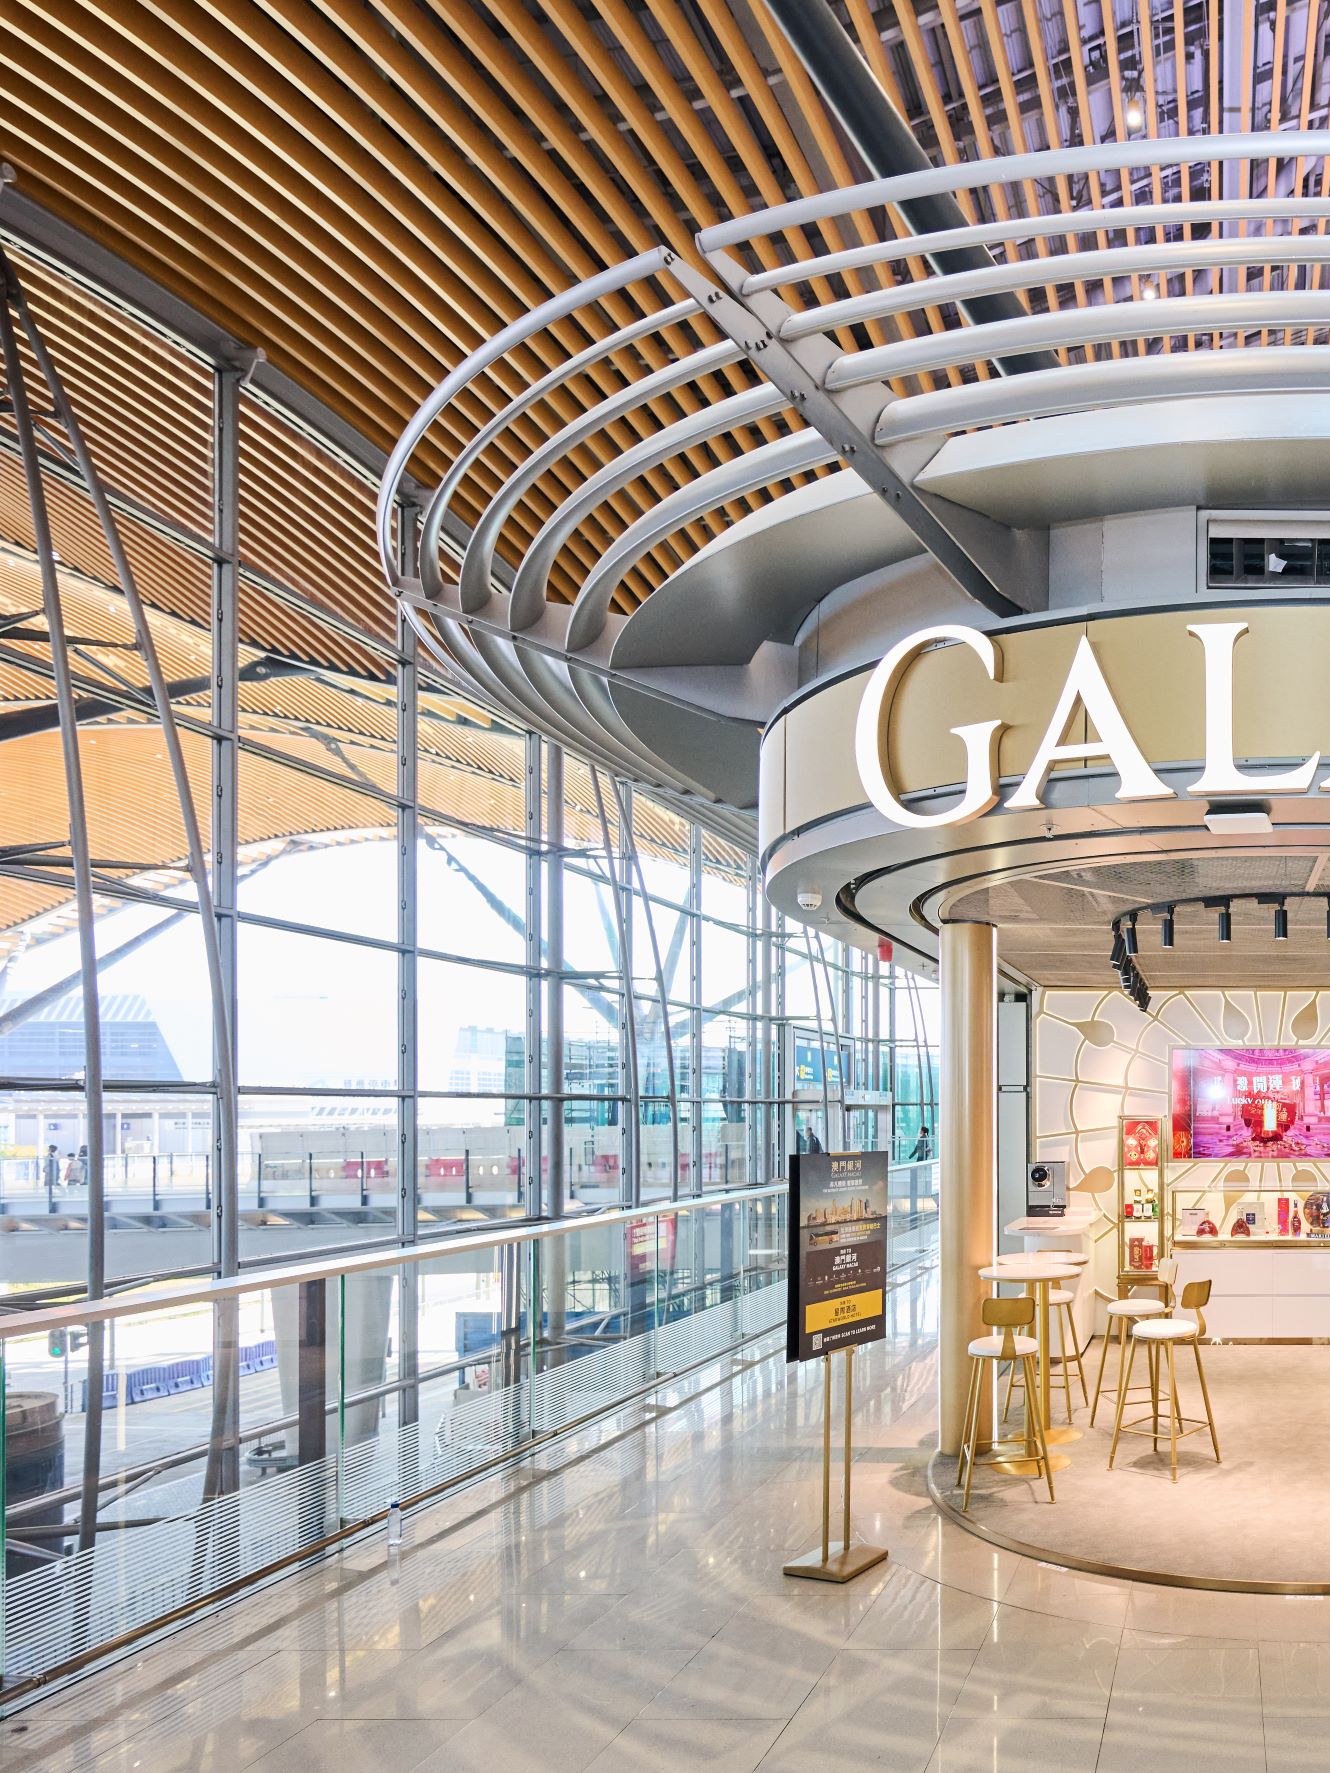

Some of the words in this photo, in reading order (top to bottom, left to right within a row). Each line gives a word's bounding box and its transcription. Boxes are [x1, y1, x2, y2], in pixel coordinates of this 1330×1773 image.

[831, 1160, 862, 1172] 澳門銀河
[834, 1253, 857, 1265] 澳門銀河
[832, 1263, 846, 1271] GALAXY
[856, 1326, 866, 1334] LEARN
